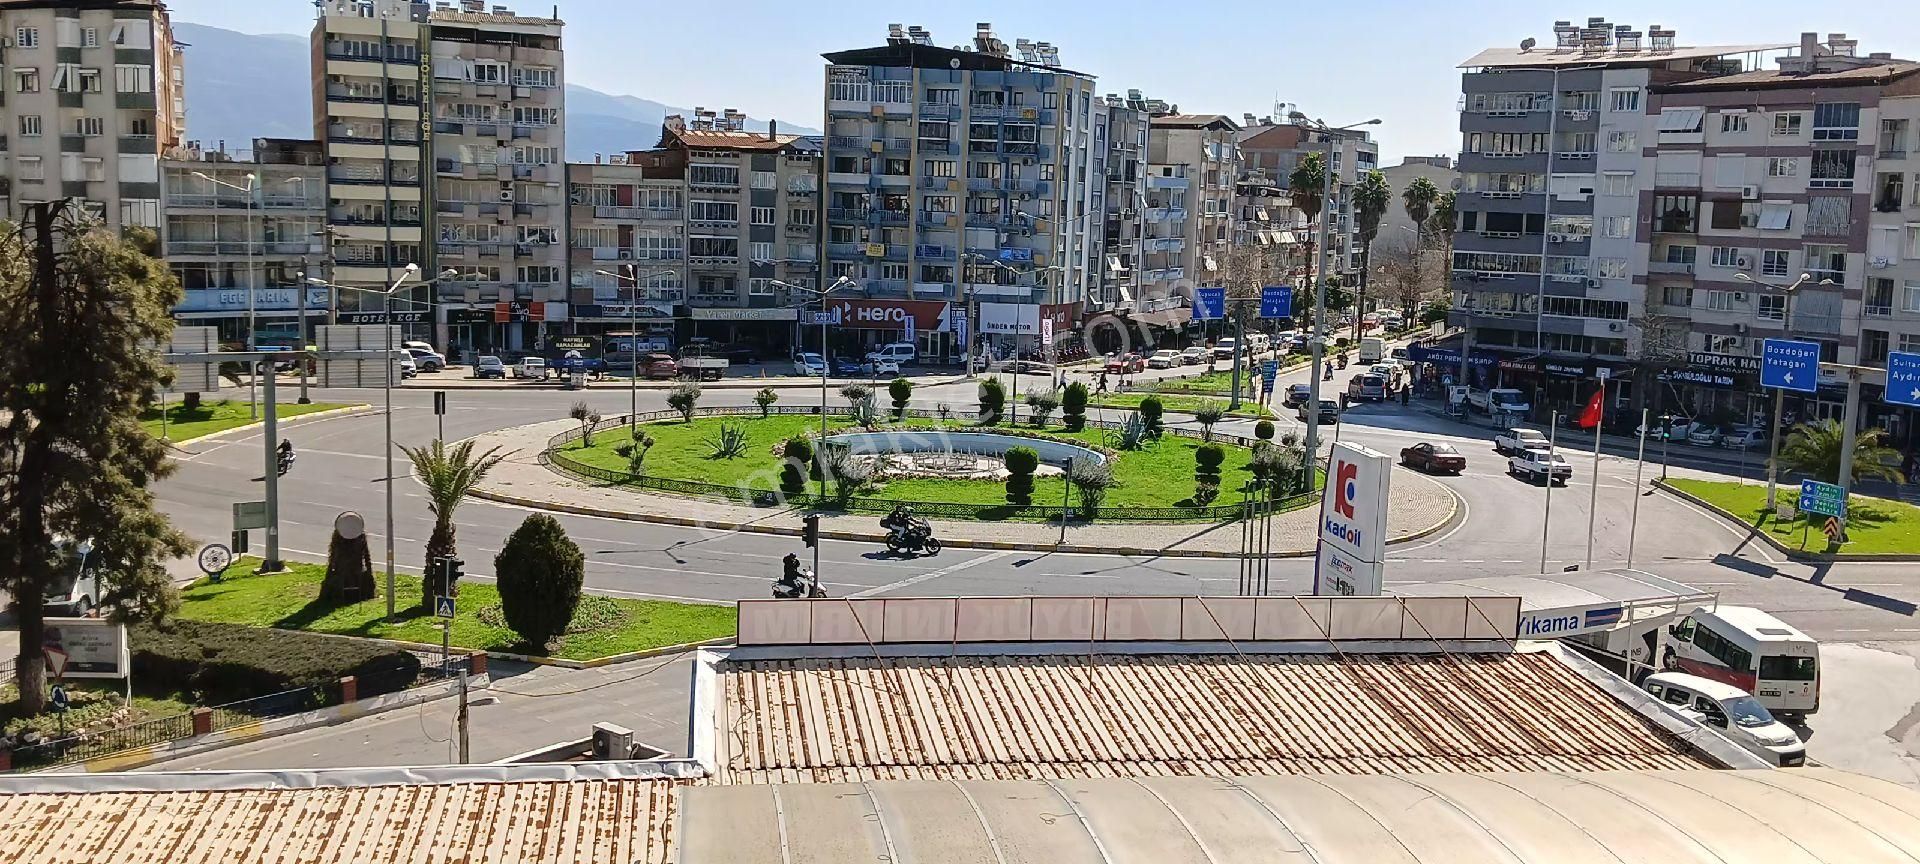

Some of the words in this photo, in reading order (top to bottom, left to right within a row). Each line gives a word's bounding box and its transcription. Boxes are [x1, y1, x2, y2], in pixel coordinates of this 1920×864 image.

[220, 293, 245, 304] EGE
[253, 292, 290, 304] ARIM
[352, 315, 391, 323] HOTEL
[397, 314, 421, 322] EGE
[1689, 353, 1737, 366] TOPRAK
[1325, 515, 1361, 547] kadoil
